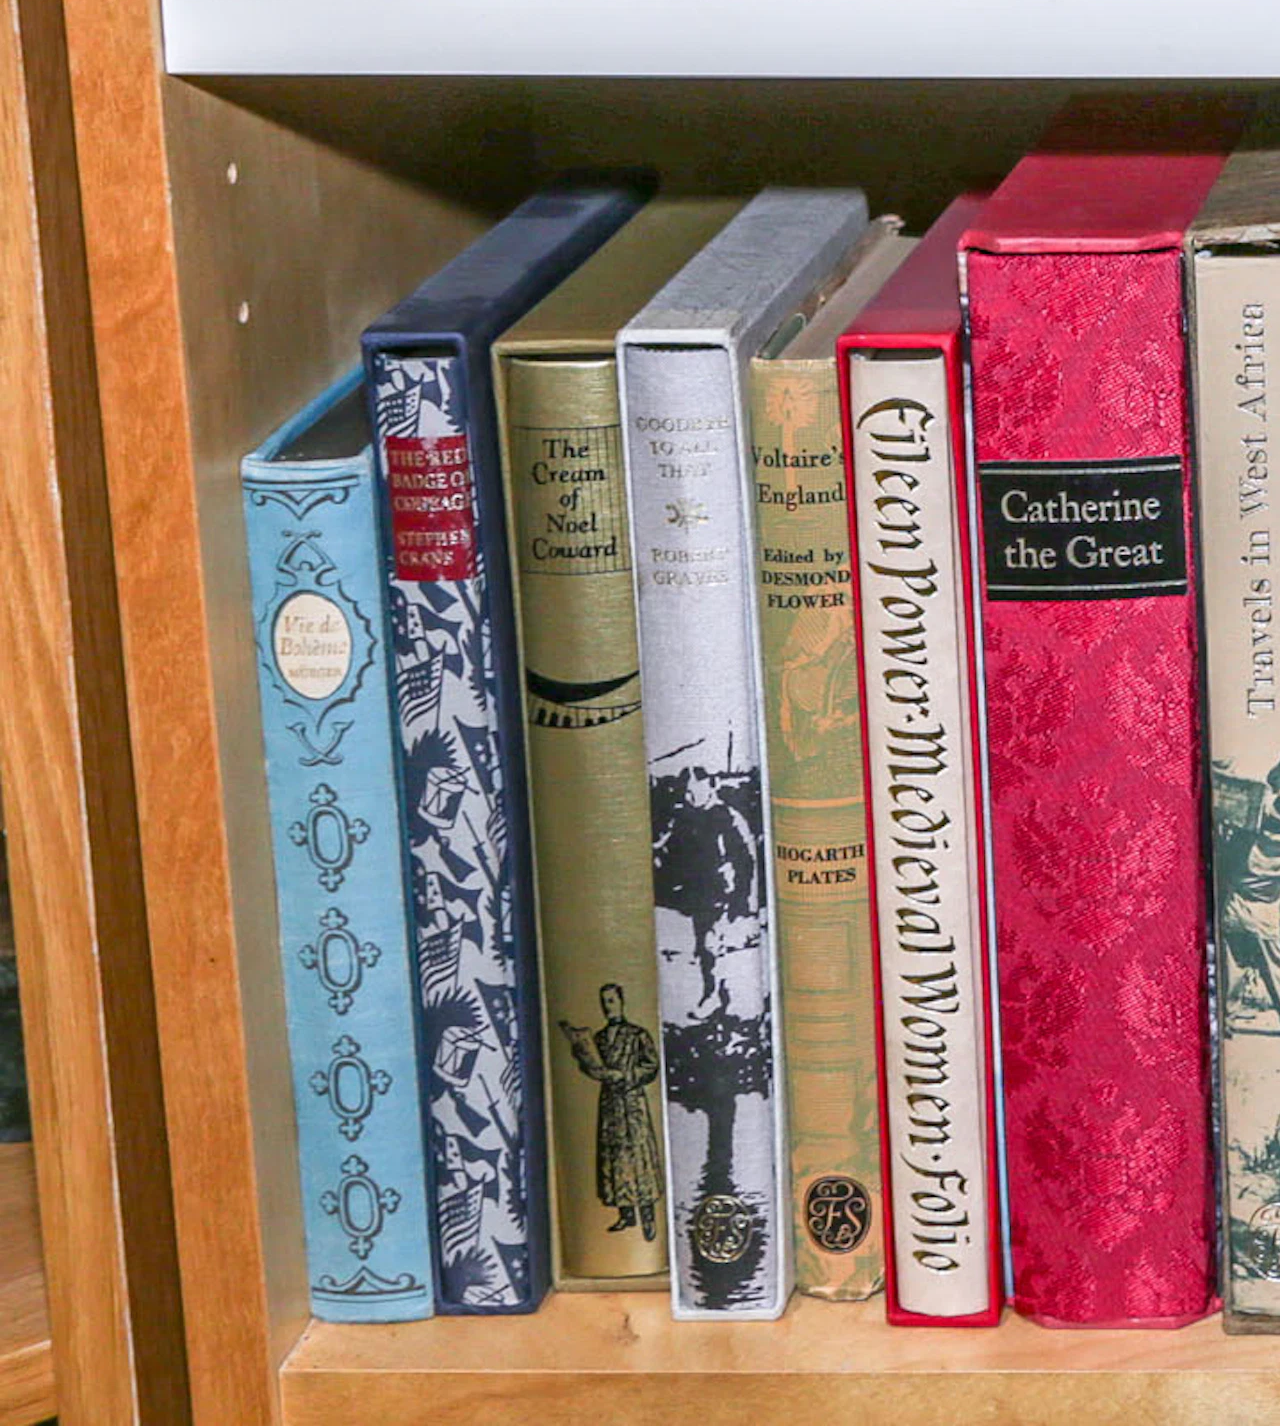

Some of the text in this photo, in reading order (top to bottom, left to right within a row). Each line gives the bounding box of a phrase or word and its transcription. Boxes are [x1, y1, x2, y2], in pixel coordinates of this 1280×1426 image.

[543, 439, 591, 458] The
[531, 464, 606, 484] Cream
[559, 488, 582, 510] of
[758, 483, 845, 510] England
[1001, 488, 1162, 525] Catherine
[1237, 301, 1276, 719] Travels in West Africa
[546, 514, 598, 534] Noel
[531, 538, 617, 560] Coward
[764, 548, 844, 565] Edited by
[1005, 532, 1163, 568] the Great
[761, 569, 851, 585] DESMOND
[768, 593, 845, 609] FLOWER
[856, 397, 972, 1273] Eileen Power Medieval Women Folio
[777, 844, 866, 861] HOGARTH
[787, 868, 856, 884] PLATES
